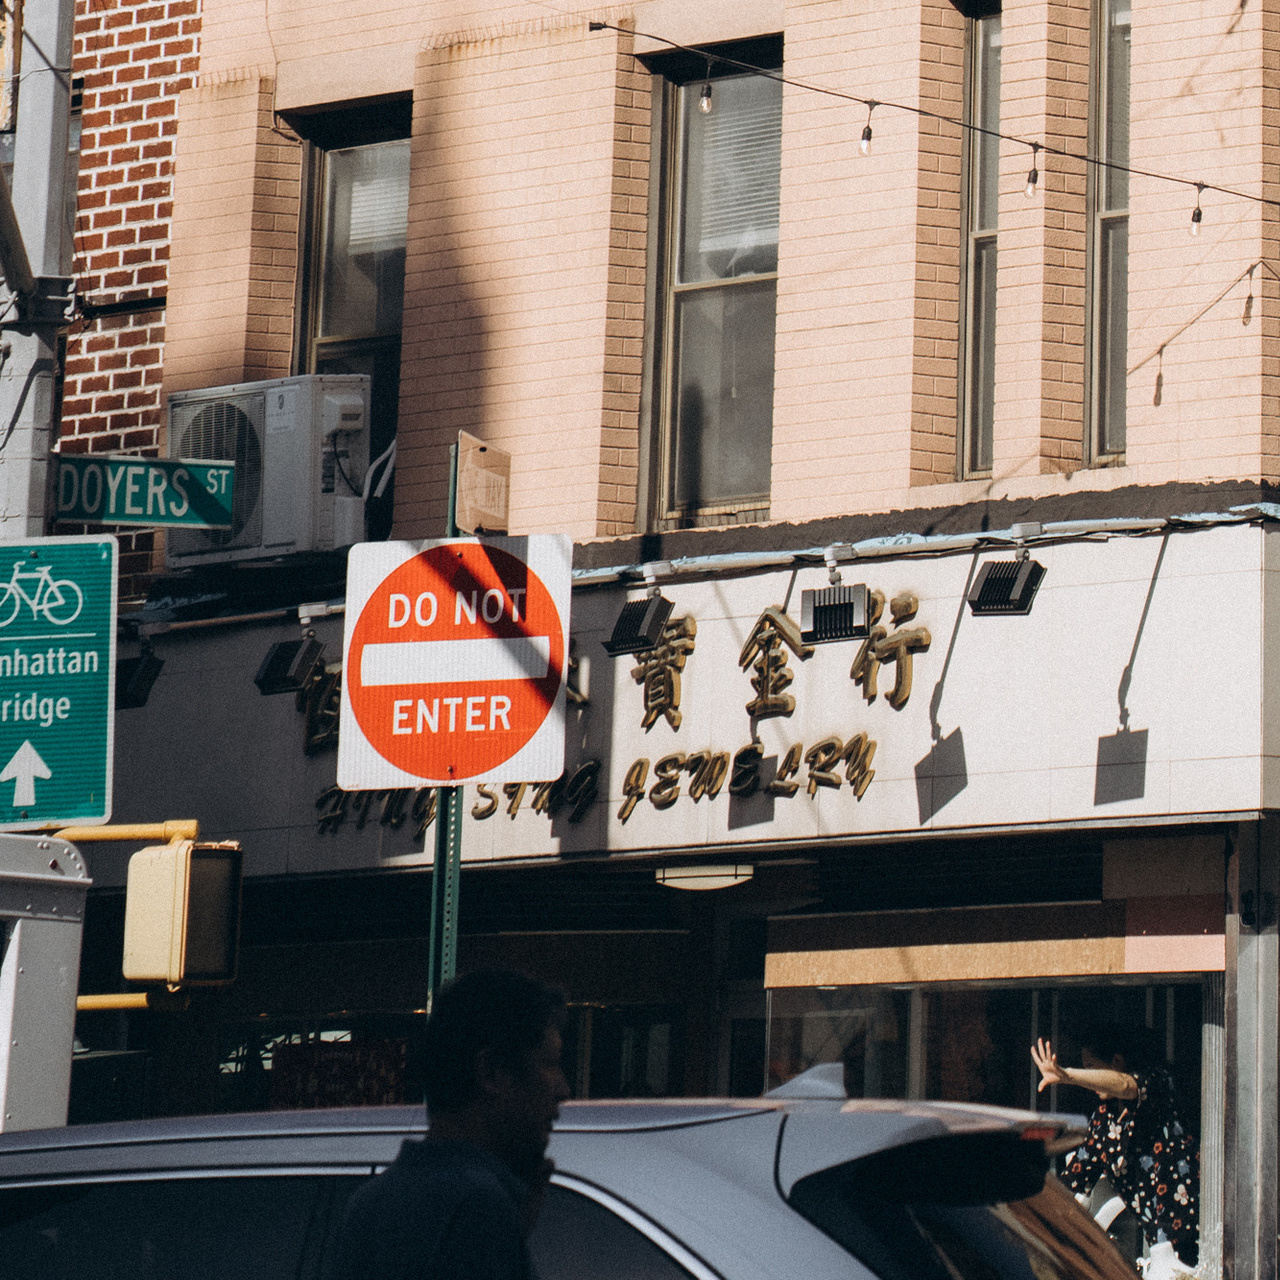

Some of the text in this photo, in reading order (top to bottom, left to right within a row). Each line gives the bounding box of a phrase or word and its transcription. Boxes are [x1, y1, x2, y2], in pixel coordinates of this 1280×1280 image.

[58, 463, 230, 517] DOYERS ST
[388, 588, 526, 628] DO NOT
[0, 647, 99, 677] nhattan
[1, 692, 71, 727] ridge
[392, 695, 512, 734] ENTER
[616, 732, 878, 823] JEWELRY
